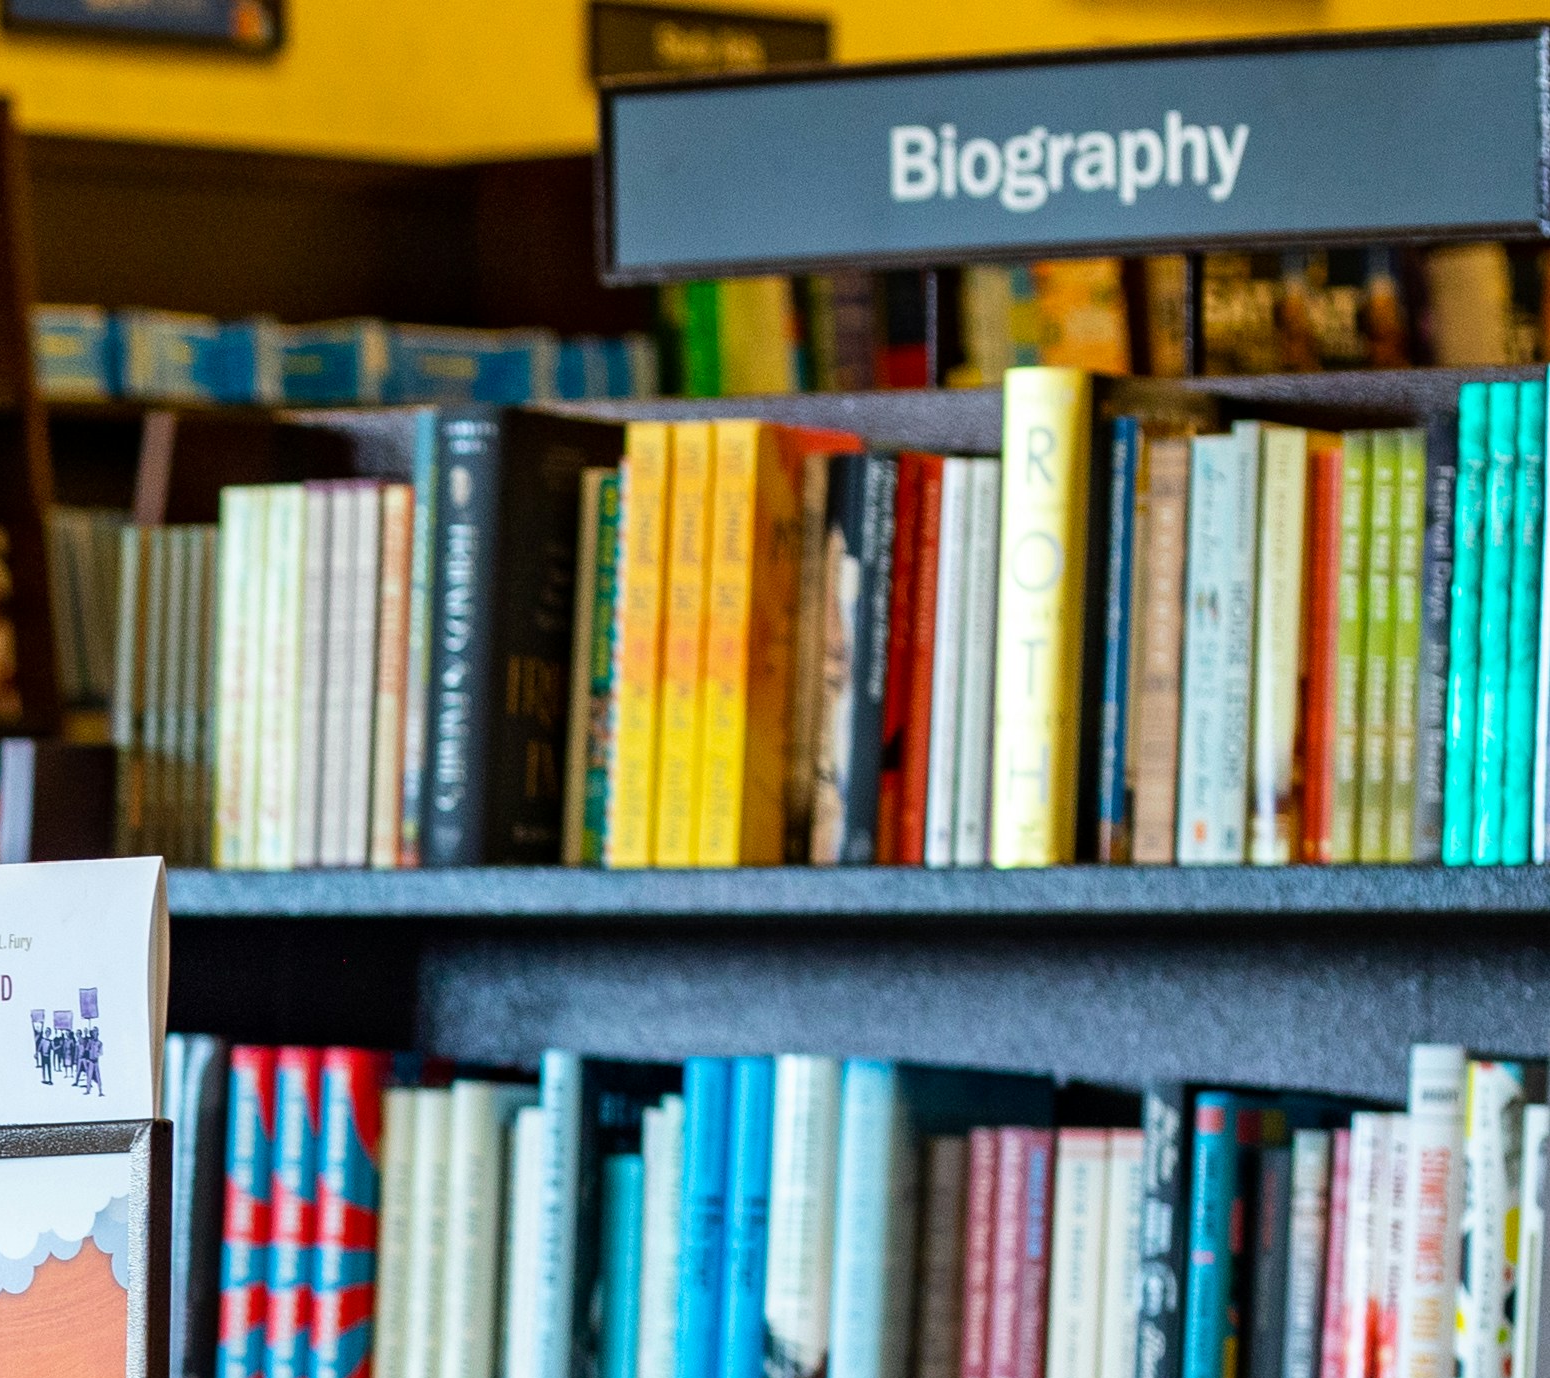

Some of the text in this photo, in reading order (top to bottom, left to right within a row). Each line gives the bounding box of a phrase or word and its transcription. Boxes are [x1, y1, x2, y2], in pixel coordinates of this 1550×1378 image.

[888, 111, 1248, 211] Biography
[1427, 559, 1451, 622] Days
[9, 934, 32, 951] Fury
[1415, 1147, 1452, 1285] SOMETIMES
